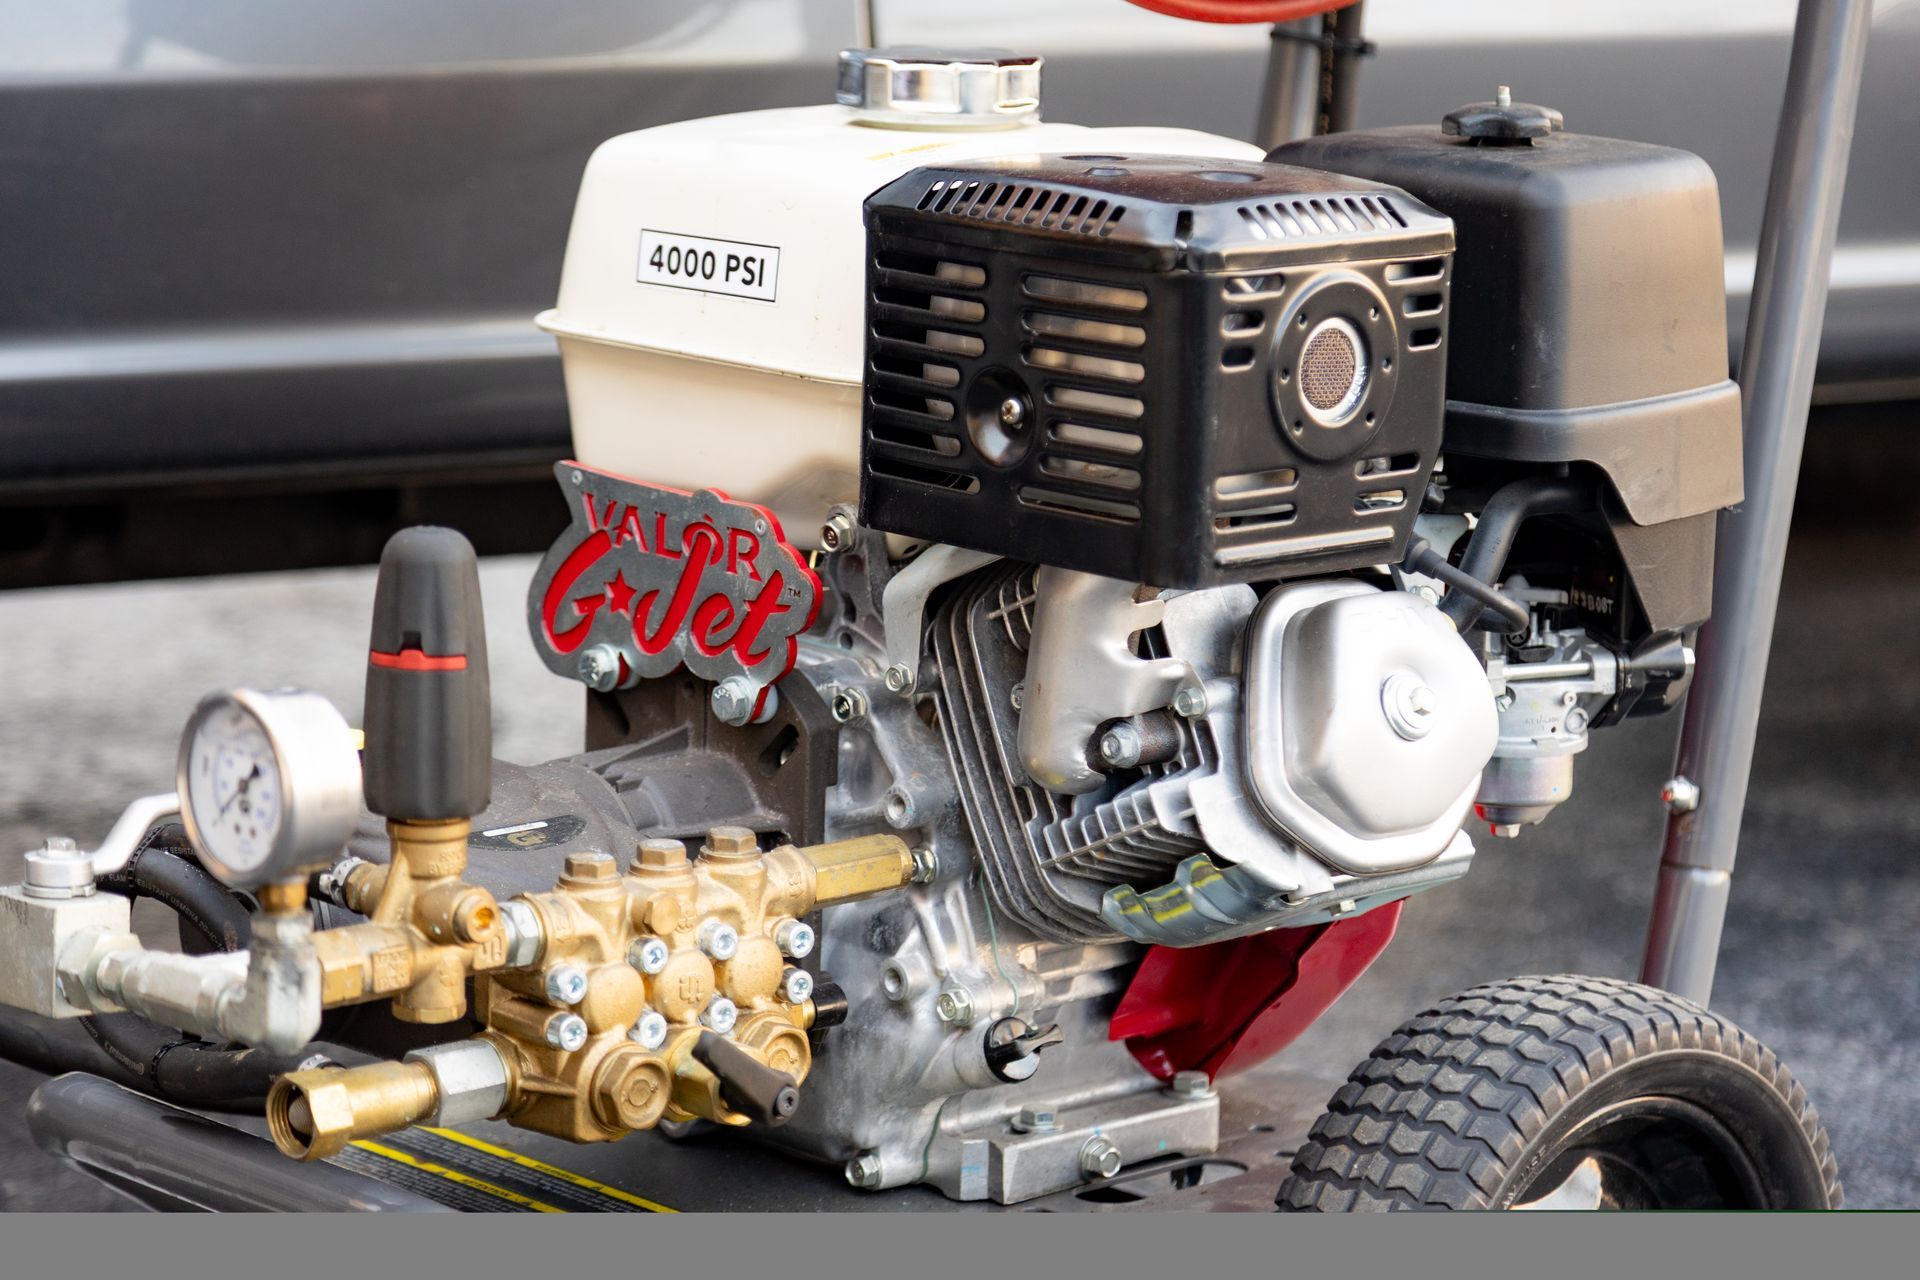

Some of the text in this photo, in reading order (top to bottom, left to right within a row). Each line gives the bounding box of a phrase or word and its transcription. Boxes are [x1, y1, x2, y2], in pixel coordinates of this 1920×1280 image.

[649, 244, 765, 287] 4000 PSI
[582, 492, 763, 582] VALOR
